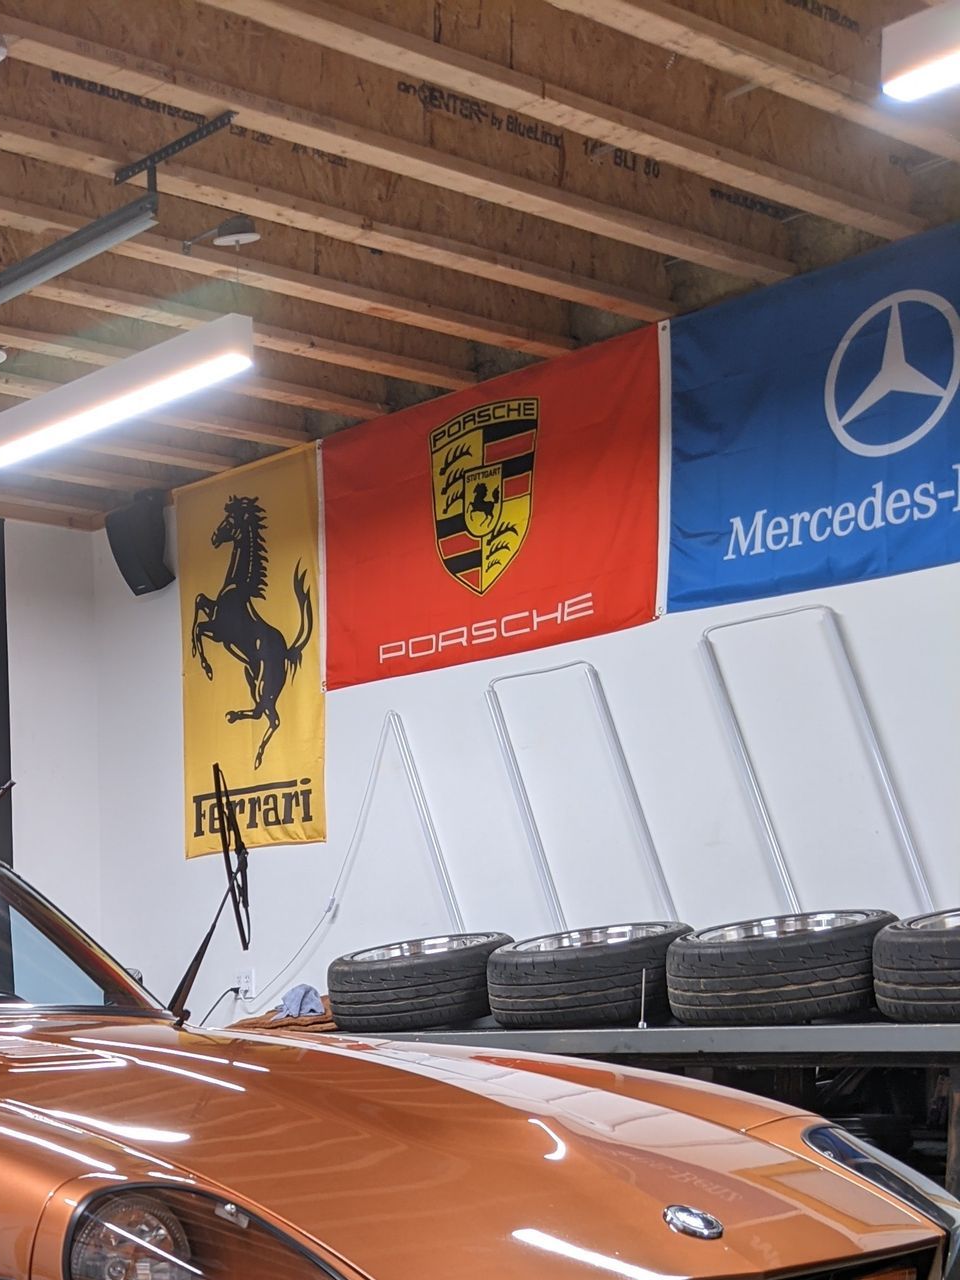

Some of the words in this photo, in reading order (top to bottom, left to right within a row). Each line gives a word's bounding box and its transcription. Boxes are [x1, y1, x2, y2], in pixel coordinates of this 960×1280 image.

[490, 111, 503, 131] by
[505, 114, 562, 149] BlueLinx
[433, 402, 534, 448] PORSCHE
[466, 467, 500, 484] STUTTGART
[379, 592, 594, 664] PORSCHE
